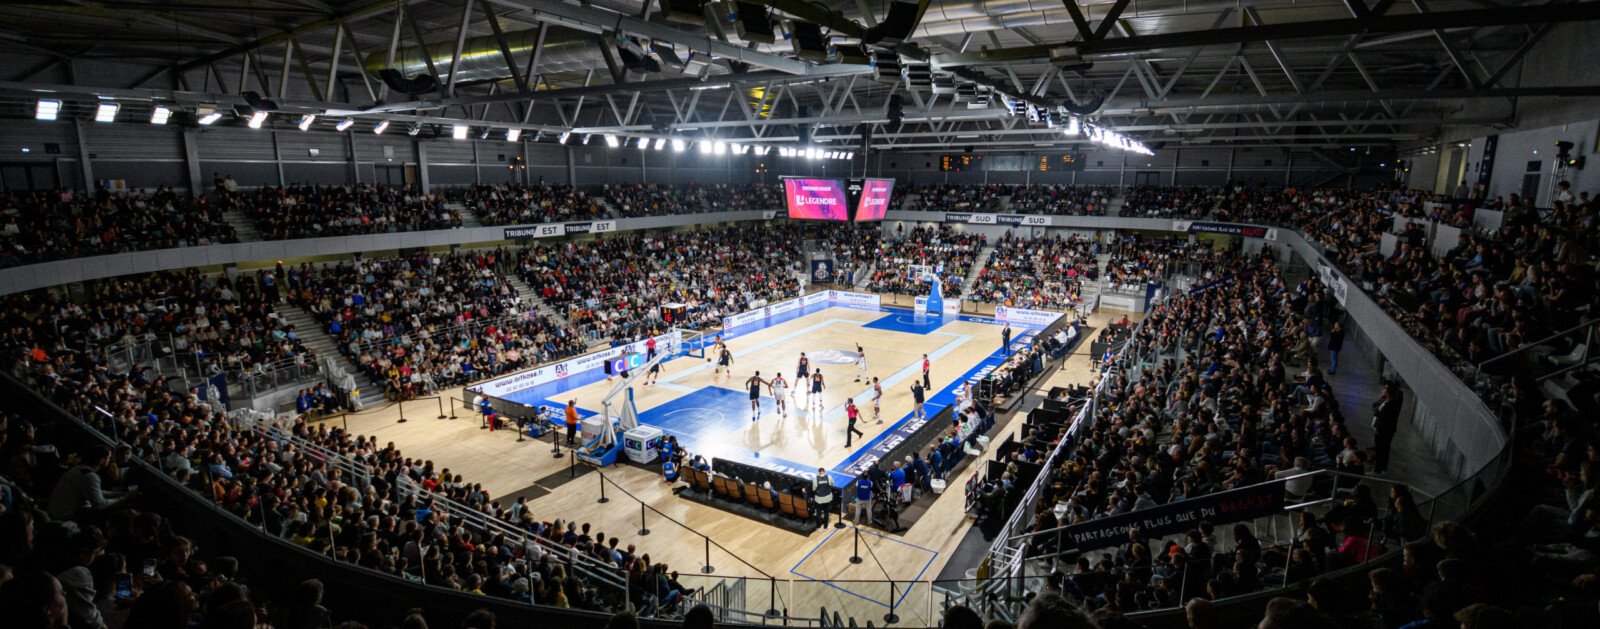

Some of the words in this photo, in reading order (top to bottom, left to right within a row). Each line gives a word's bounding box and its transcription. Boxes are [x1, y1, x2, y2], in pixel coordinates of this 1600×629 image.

[805, 197, 837, 206] LEGENDRE
[506, 228, 536, 237] TRIBUNE
[542, 226, 558, 235] EST
[566, 224, 591, 232] TRIBUNE
[596, 222, 610, 231] EST
[555, 362, 569, 374] Art
[614, 355, 639, 372] CIC
[494, 369, 544, 388] www.artkose.fr
[626, 440, 642, 451] CIC
[1073, 523, 1141, 545] PARTAGEONS
[1143, 516, 1172, 530] PLUS
[1175, 510, 1197, 524] QUE
[1201, 508, 1216, 519] DU
